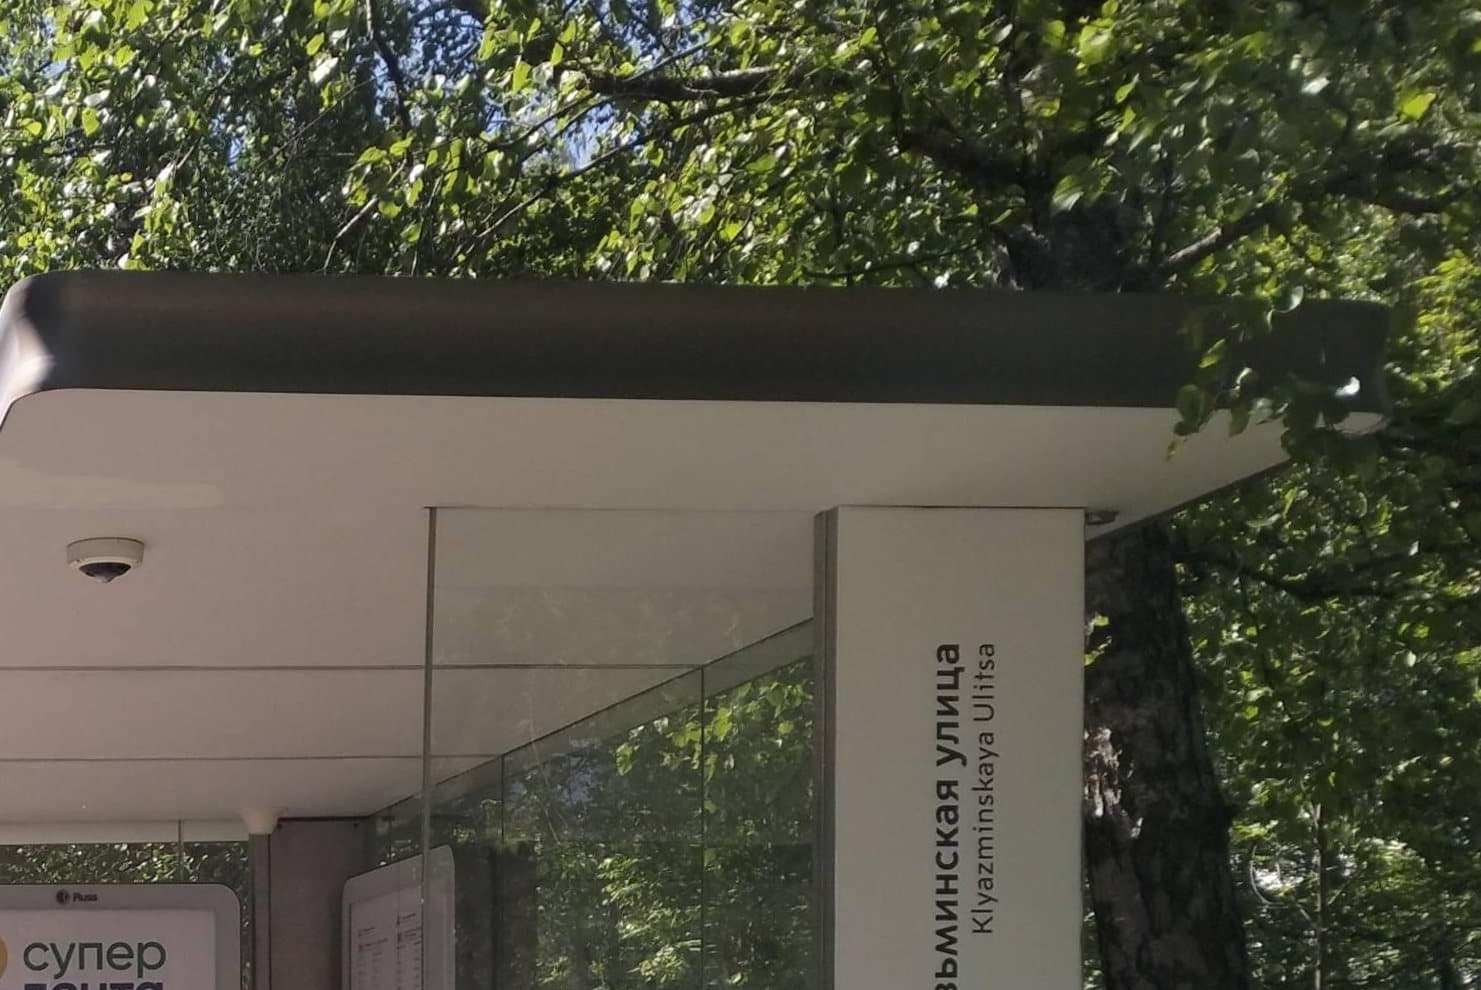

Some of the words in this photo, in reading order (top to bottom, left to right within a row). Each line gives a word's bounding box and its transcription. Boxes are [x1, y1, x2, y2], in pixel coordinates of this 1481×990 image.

[935, 643, 967, 768] улица
[971, 642, 995, 723] Ulitsa
[971, 731, 999, 935] Klyazminskaya
[23, 941, 167, 980] супер
